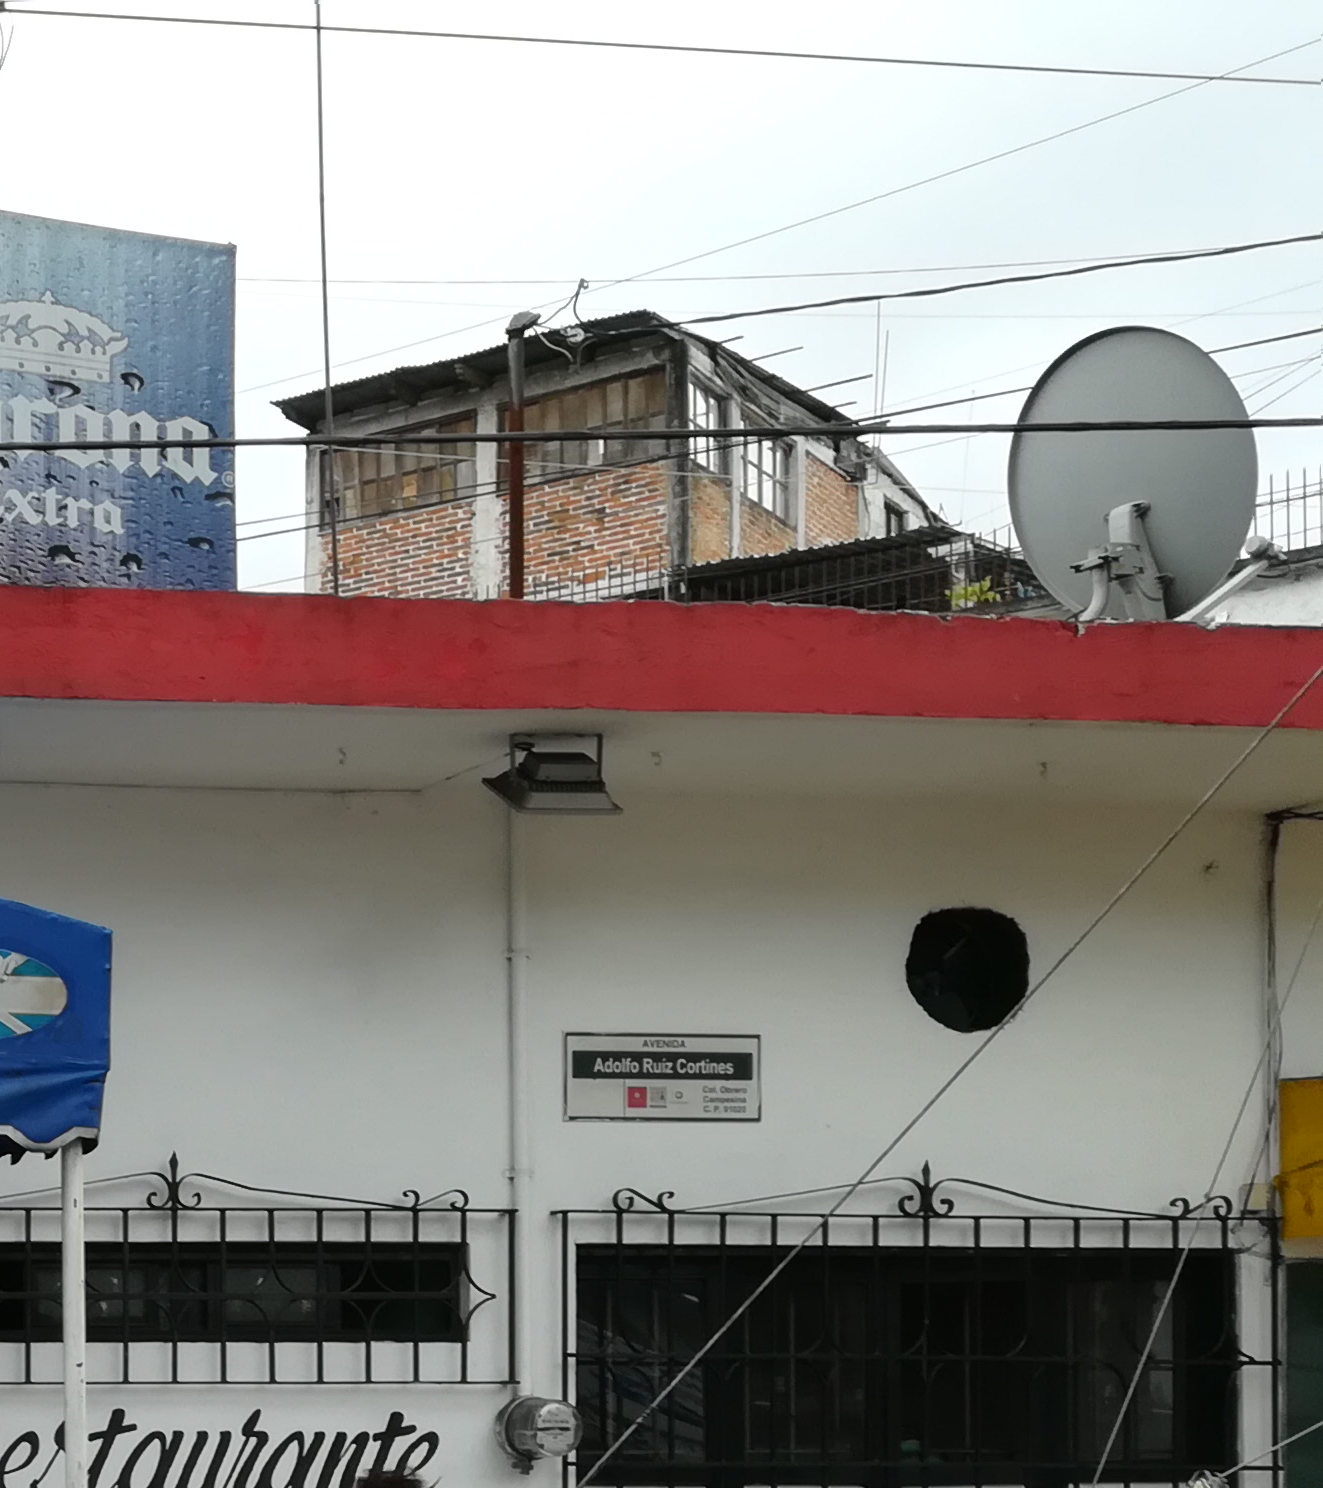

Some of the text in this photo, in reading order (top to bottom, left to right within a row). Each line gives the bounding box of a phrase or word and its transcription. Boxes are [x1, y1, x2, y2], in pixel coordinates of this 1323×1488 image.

[641, 1039, 687, 1049] AVENIDA
[593, 1057, 640, 1073] Adolfo
[676, 1058, 734, 1075] Cortines
